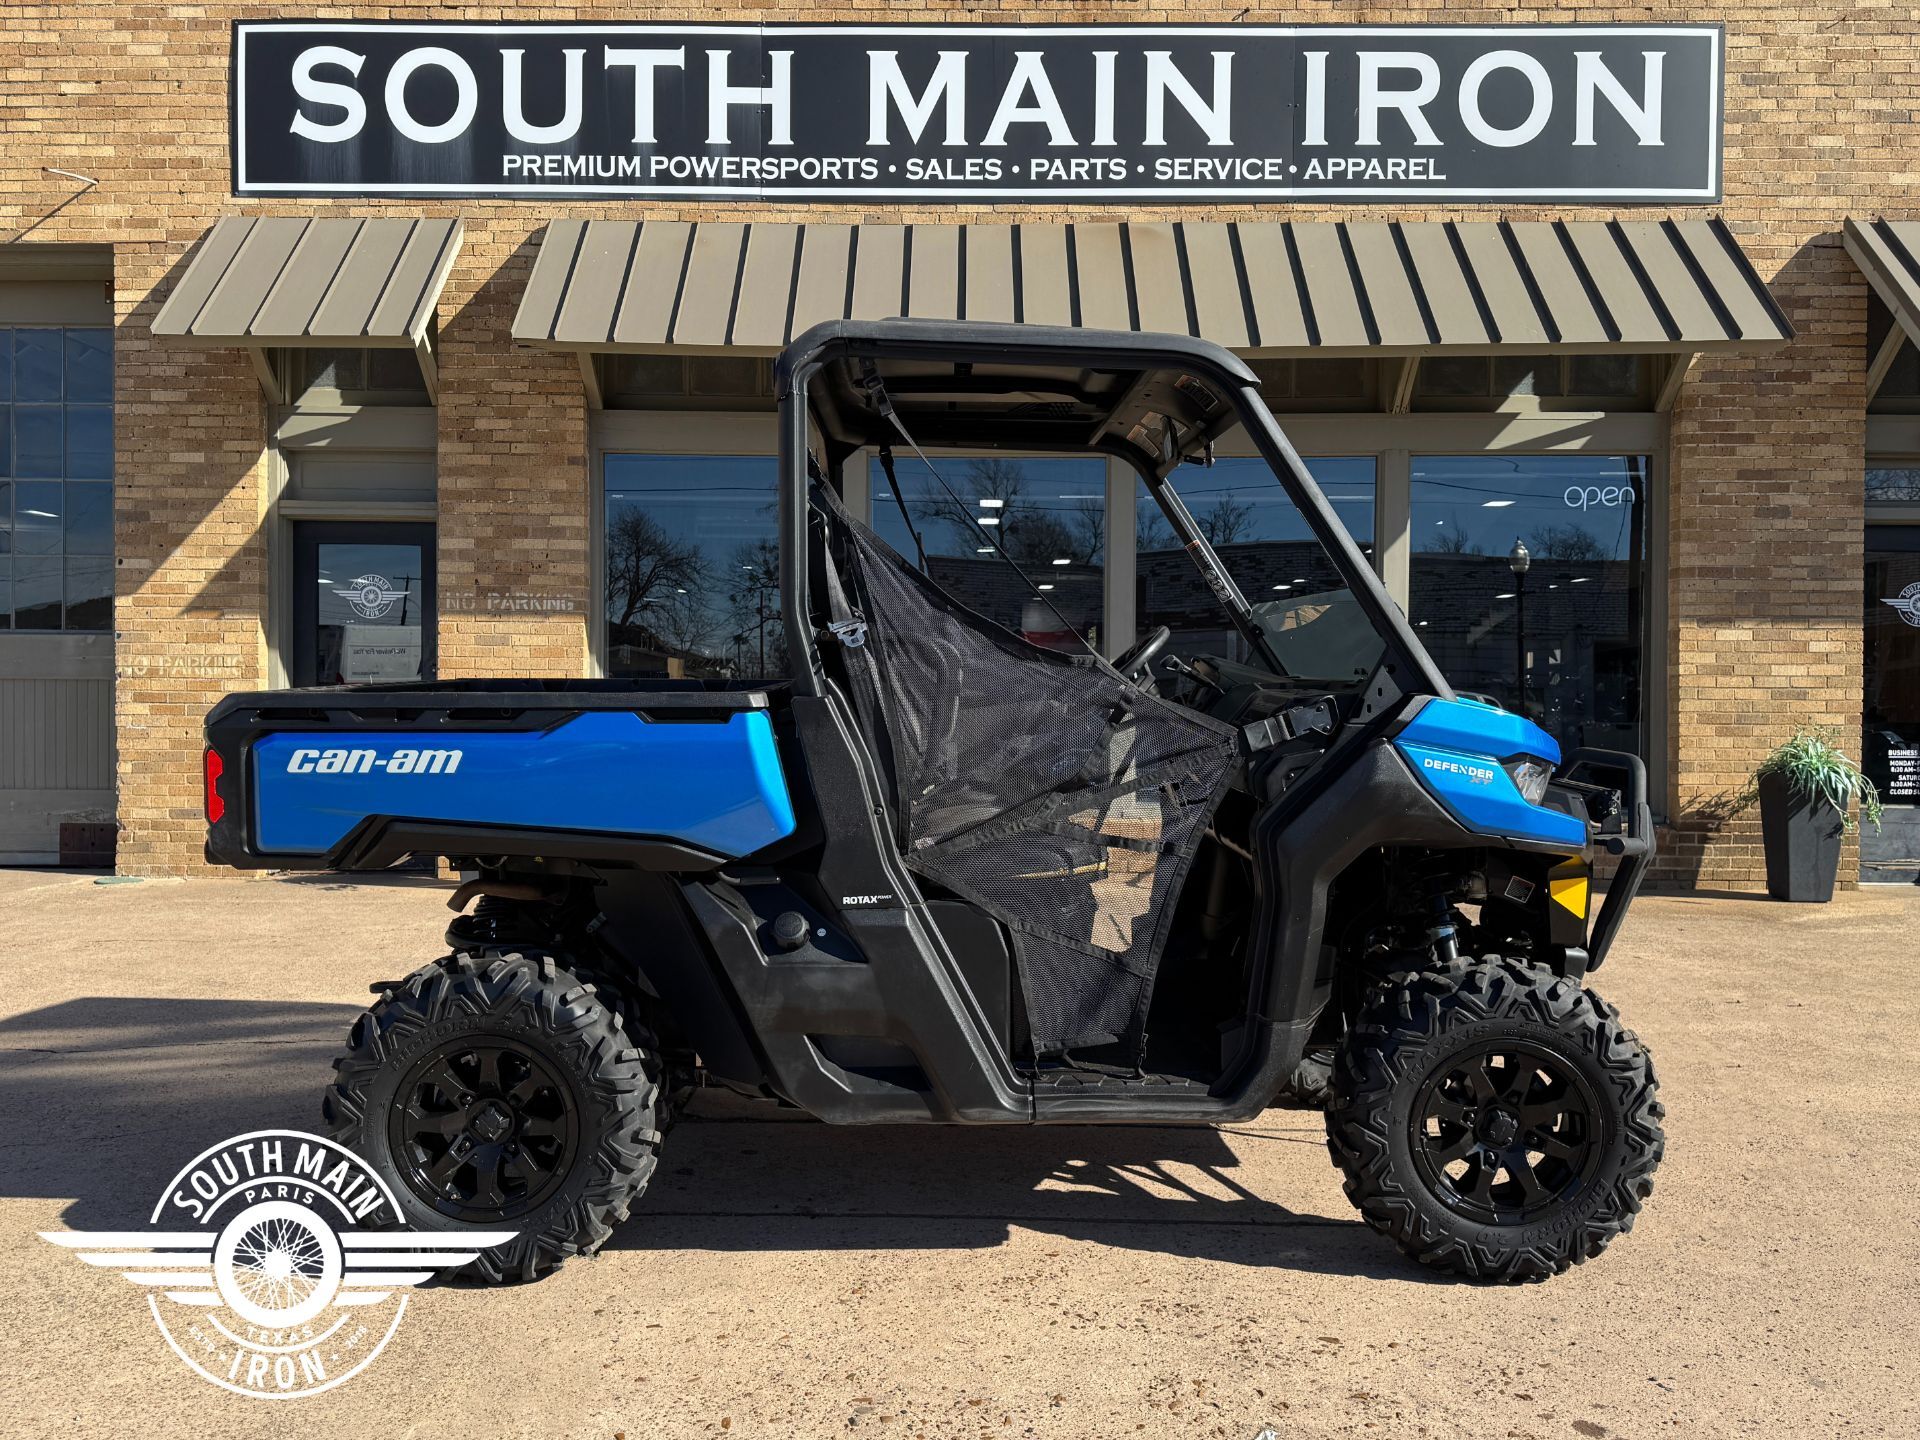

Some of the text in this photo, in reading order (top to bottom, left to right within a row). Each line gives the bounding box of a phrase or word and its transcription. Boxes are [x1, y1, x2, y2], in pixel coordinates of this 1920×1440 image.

[289, 45, 1667, 147] SOUTH MAIN IRON
[502, 154, 1447, 181] PREMIUM POWERSPORTS SALES PARTS SERVICE APPAREL
[1563, 486, 1636, 512] open
[446, 592, 575, 611] NO PARKING
[286, 749, 463, 774] can-am
[1424, 758, 1494, 780] DEFENDER
[842, 895, 878, 905] ROTAX
